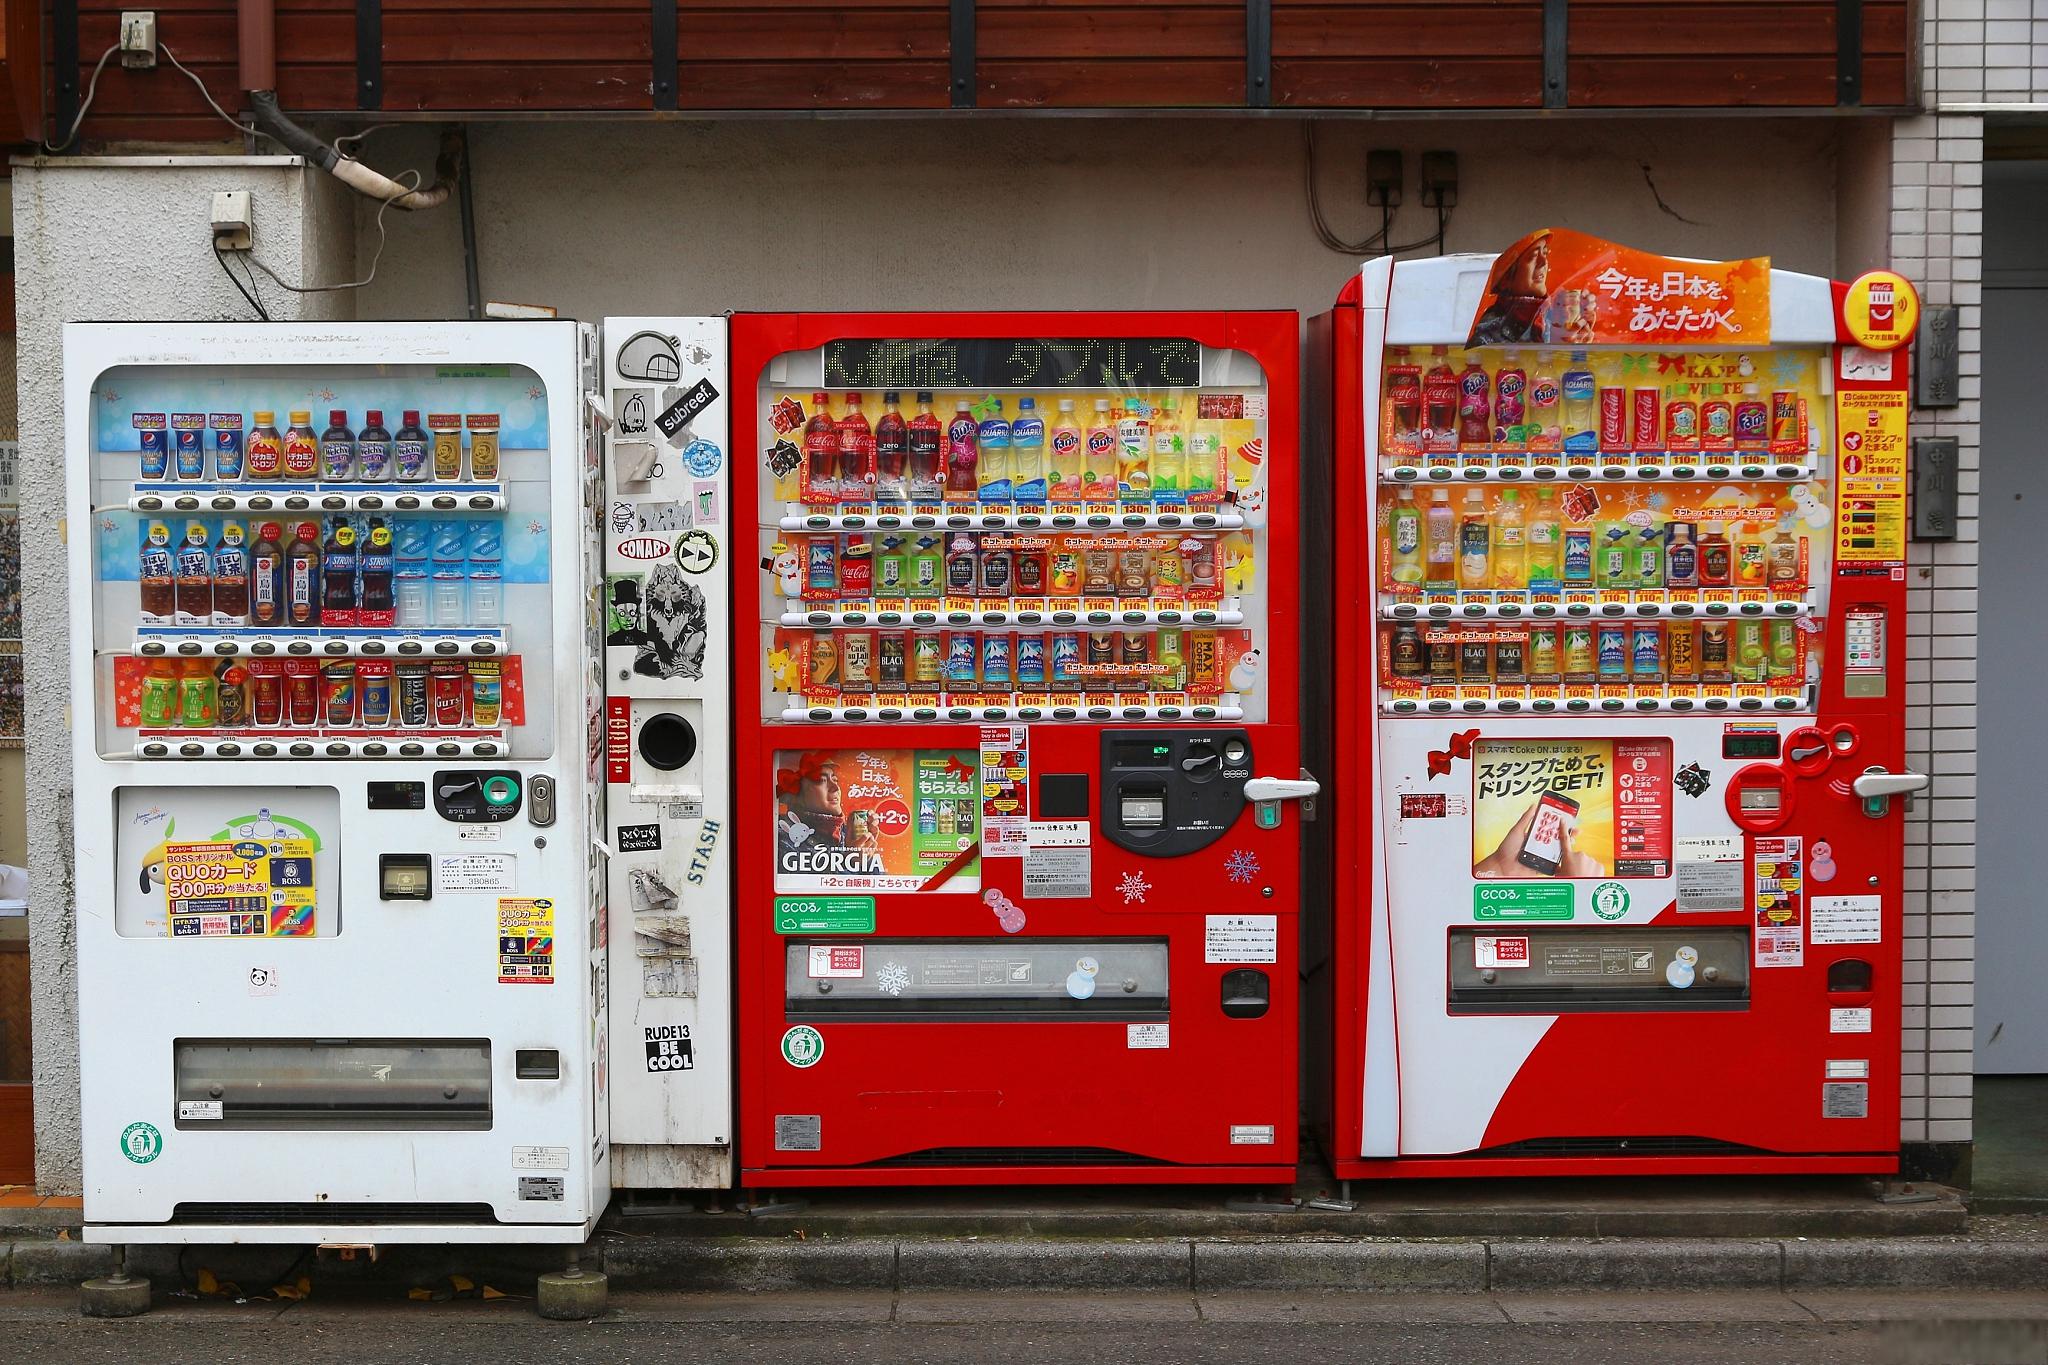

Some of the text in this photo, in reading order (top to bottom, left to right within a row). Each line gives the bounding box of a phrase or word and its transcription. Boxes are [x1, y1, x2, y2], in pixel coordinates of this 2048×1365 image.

[1596, 267, 1729, 302] 今年も日本を、
[1629, 302, 1743, 333] あたたかく。
[1863, 333, 1901, 341] スマホ自販機
[1463, 373, 1489, 393] Fanta
[1500, 378, 1526, 395] Fanta
[1534, 387, 1559, 402] Fanta
[1603, 394, 1620, 443] Coca-Cola
[1637, 394, 1654, 443] Coca-Cola
[1739, 413, 1767, 430] Fanta
[950, 420, 977, 443] Fanta
[1675, 426, 1692, 435] Qoo
[1709, 426, 1727, 435] Qoo
[1054, 436, 1079, 450] Fanta
[1089, 436, 1114, 450] Fanta
[1864, 435, 1903, 443] スタンプが
[882, 442, 899, 450] zero
[920, 442, 936, 450] zero
[252, 460, 276, 468] ストロング
[288, 460, 313, 468] ストロング
[1429, 458, 1455, 467] 140円
[1500, 458, 1525, 467] 140円
[1568, 457, 1593, 466] 130円
[1707, 456, 1732, 465] 110円
[1776, 456, 1802, 465] 100円
[1864, 455, 1902, 464] 15スタンプで
[879, 506, 906, 515] 140円
[1019, 505, 1045, 514] 130円
[1054, 505, 1079, 514] 120円
[1089, 505, 1114, 514] 120円
[1123, 505, 1149, 514] 130円
[1158, 505, 1183, 514] 100円
[620, 539, 669, 559] CONART
[1158, 559, 1177, 568] 食べる
[143, 564, 168, 577] 麦茶
[181, 564, 205, 577] 麦茶
[217, 564, 242, 577] 麦茶
[1430, 595, 1455, 604] 140円
[1464, 595, 1490, 603] 130円
[1499, 594, 1524, 603] 120円
[1602, 593, 1626, 602] 110円
[1637, 593, 1662, 602] 110円
[808, 604, 834, 612] 100円
[1053, 602, 1076, 611] 110円
[1087, 602, 1111, 610] 110円
[1122, 602, 1146, 610] 110円
[1158, 602, 1181, 610] 110円
[850, 645, 866, 653] Café
[1464, 648, 1486, 658] BLACK
[1499, 648, 1521, 658] BLACK
[1681, 633, 1692, 664] MAX
[881, 656, 904, 666] BLACK
[1203, 642, 1213, 673] MAX
[1462, 689, 1488, 698] 100円
[1532, 689, 1558, 697] 100円
[1567, 689, 1593, 697] 100円
[412, 680, 425, 724] BLACK
[843, 698, 870, 706] 100円
[879, 697, 903, 706] 100円
[1021, 697, 1046, 705] 100円
[1087, 697, 1112, 706] 110円
[1123, 697, 1147, 706] 110円
[855, 751, 888, 770] 今年も
[1478, 754, 1605, 779] スタンプためて、
[861, 768, 895, 785] 日本を、
[919, 780, 975, 795] もらえる!
[1478, 771, 1604, 799] ドリンクGET!
[848, 784, 904, 799] あたたかく。
[1634, 789, 1661, 797] 15スタンプで
[877, 810, 909, 825] +2℃
[687, 818, 721, 886] STASH
[782, 843, 885, 873] GEORGIA
[167, 862, 257, 880] QUOカード
[281, 877, 302, 885] BOSS
[500, 910, 546, 919] QUOカード
[644, 1024, 690, 1041] RUDE13
[658, 1041, 679, 1056] BE
[648, 1054, 693, 1071] COOL
[122, 1122, 160, 1140] のんだあとは
[126, 1150, 160, 1164] リサイクル
